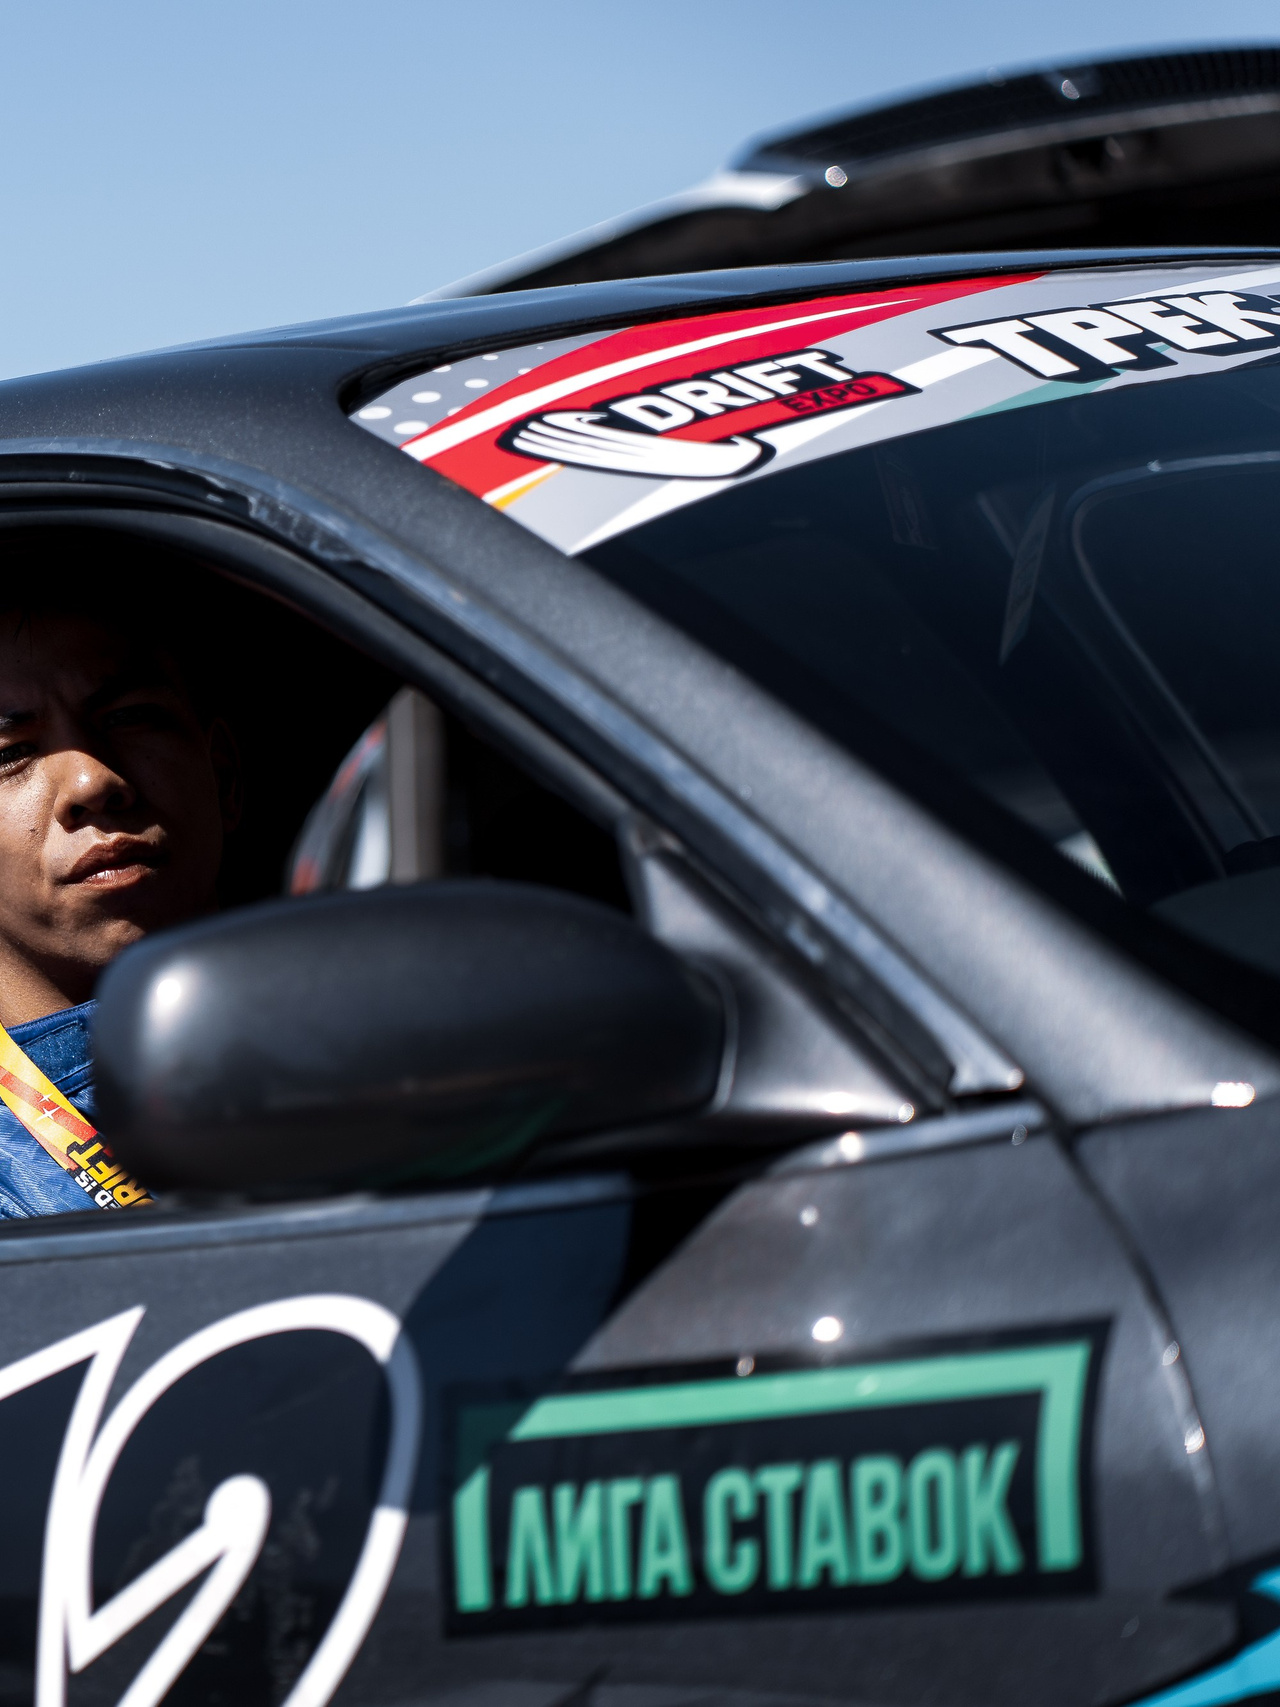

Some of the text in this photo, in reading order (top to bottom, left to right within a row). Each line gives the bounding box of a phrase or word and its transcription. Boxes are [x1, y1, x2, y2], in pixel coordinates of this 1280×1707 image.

[608, 350, 854, 433] DRIFT
[778, 382, 878, 414] EXPO
[68, 1142, 155, 1208] RIFT
[504, 1440, 1023, 1607] ЛИГА СТАВОК
